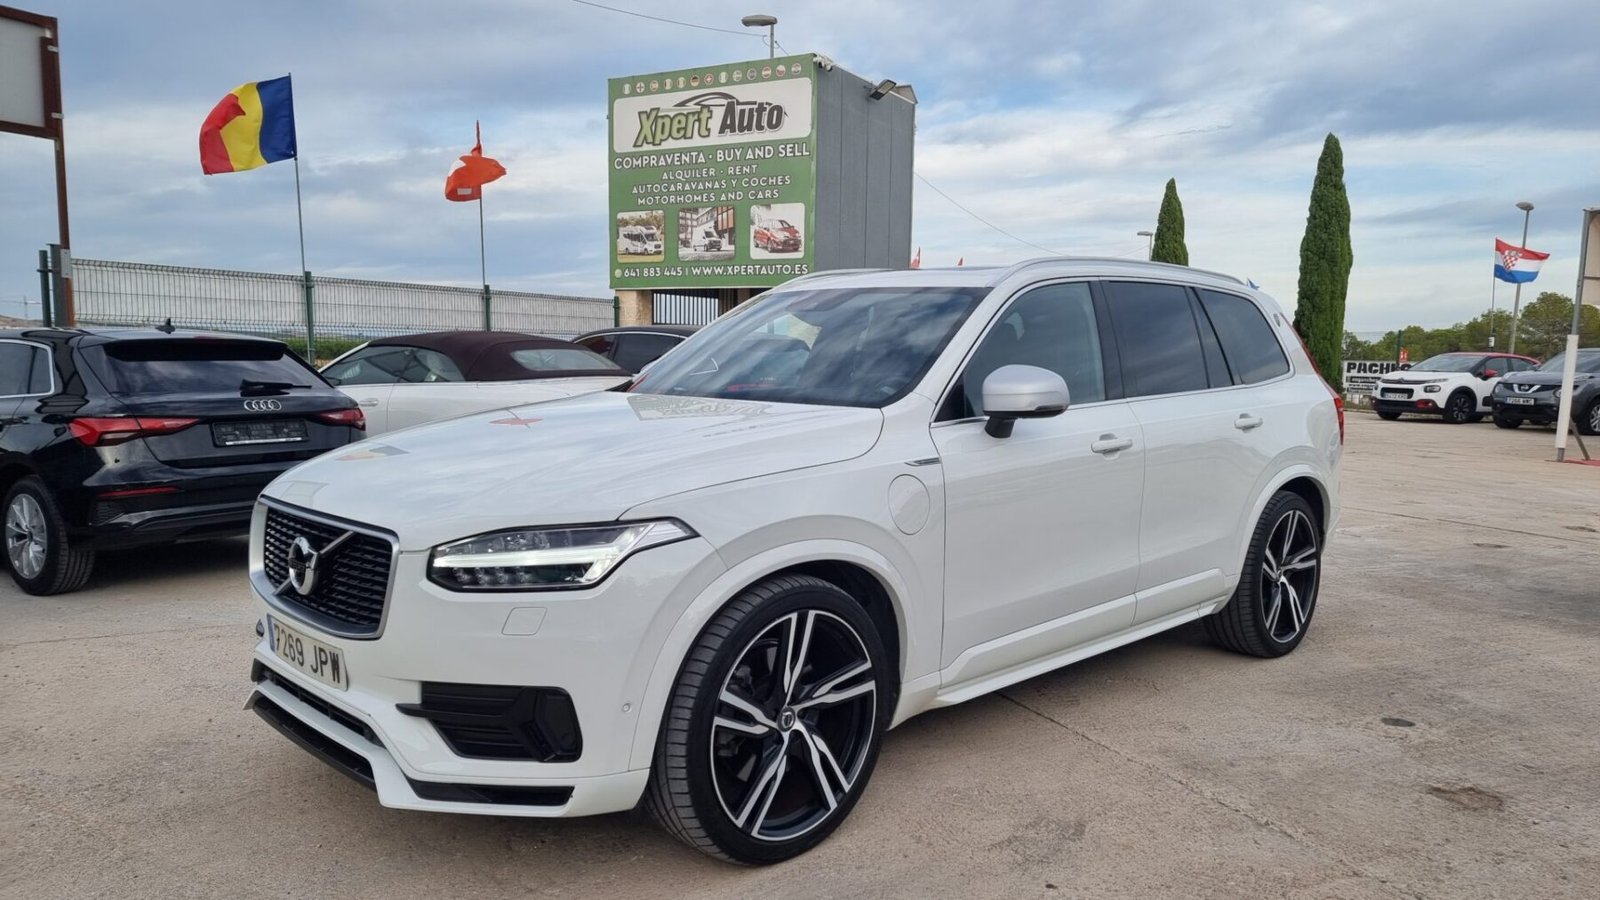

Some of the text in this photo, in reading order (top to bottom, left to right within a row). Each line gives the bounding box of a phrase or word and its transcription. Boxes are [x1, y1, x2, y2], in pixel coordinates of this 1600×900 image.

[633, 100, 785, 148] Xpert Auto
[614, 142, 810, 169] COMPRAVENTA BUY AND SELL
[662, 164, 758, 181] ALQUILER RENT
[632, 175, 791, 194] AUTOCARAVANAS Y COCHES
[637, 189, 780, 206] MOTORHOMES AND CARS
[623, 264, 809, 277] 641 883 445 WWW.XPERTAUTO.ES
[273, 623, 341, 684] 7269 JPW
